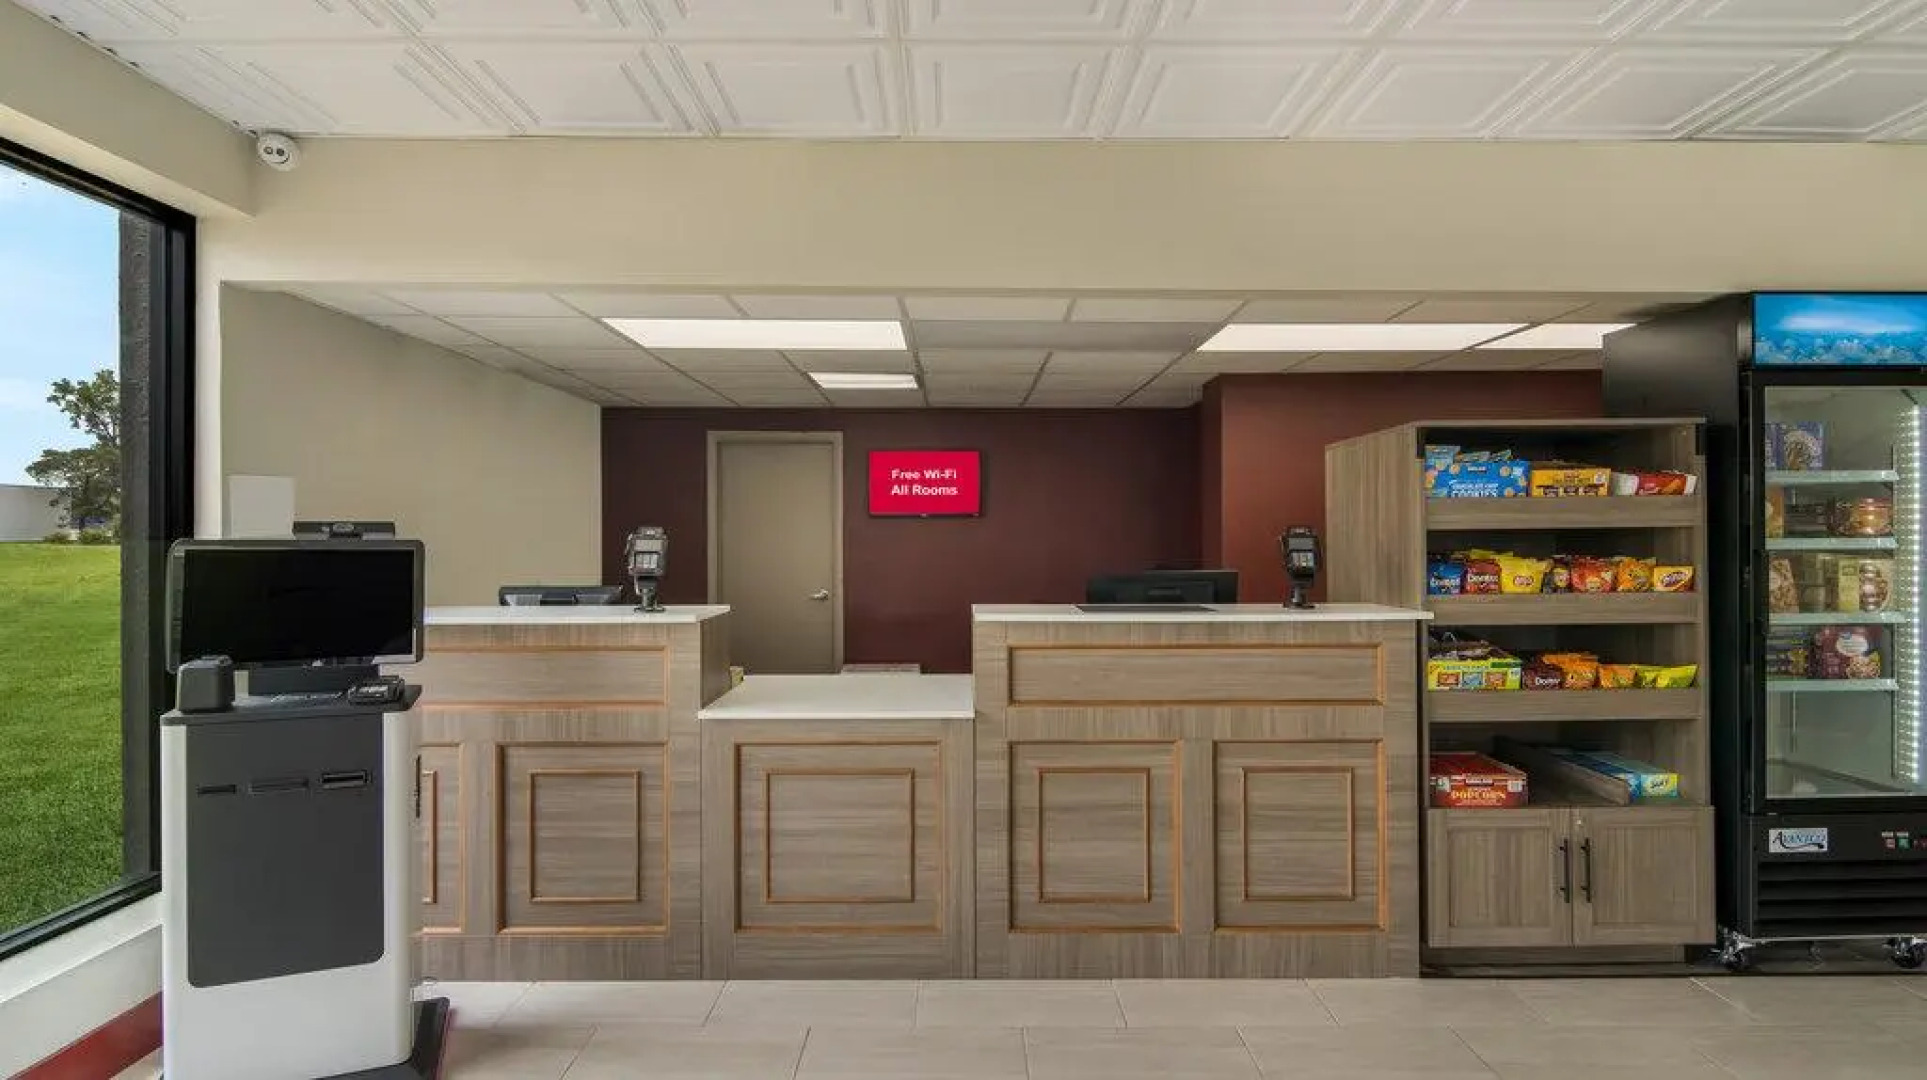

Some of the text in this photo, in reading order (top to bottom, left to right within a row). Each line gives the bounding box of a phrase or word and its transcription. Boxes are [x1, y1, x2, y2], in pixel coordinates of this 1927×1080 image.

[891, 468, 957, 479] Free Wi-Fi
[891, 484, 958, 496] All Rooms
[1451, 789, 1506, 800] POPCORN
